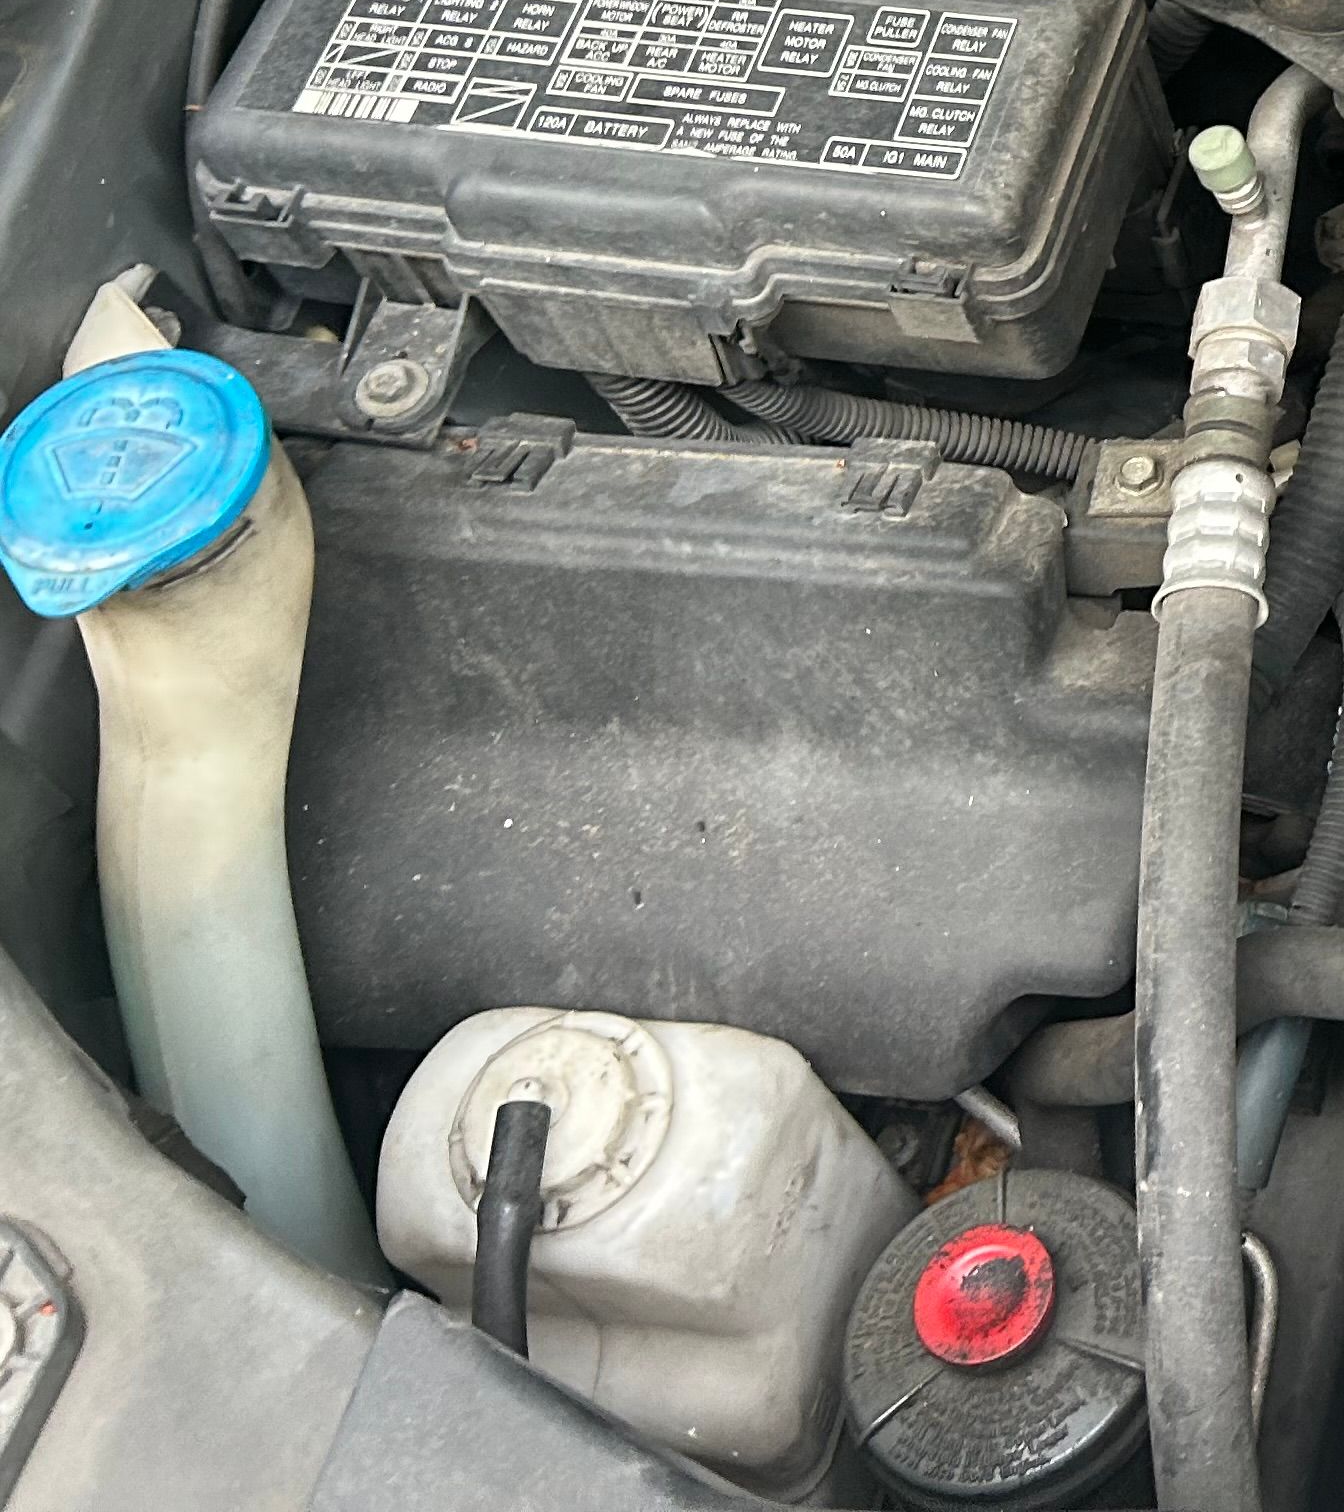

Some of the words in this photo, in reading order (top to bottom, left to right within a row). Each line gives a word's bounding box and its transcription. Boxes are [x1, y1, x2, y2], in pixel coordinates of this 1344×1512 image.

[368, 2, 406, 16] RELAY
[522, 3, 556, 17] HORN
[600, 9, 634, 23] MOTOR
[441, 9, 479, 24] RELAY
[884, 15, 916, 28] FUSE
[513, 17, 551, 32] RELAY
[708, 19, 765, 35] DEFROSTER
[788, 20, 835, 35] HEATER
[940, 23, 988, 38] CONDENSER
[991, 28, 1009, 39] FAN
[873, 25, 919, 39] PULLER
[505, 41, 549, 57] HAZARD
[575, 38, 608, 52] BACK
[784, 35, 827, 50] MOTOR
[951, 38, 987, 53] RELAY
[427, 57, 458, 71] STOP
[701, 51, 747, 65] HEATER
[780, 50, 819, 65] RELAY
[863, 52, 917, 66] CONDENSER
[698, 62, 741, 76] MOTOR
[876, 63, 896, 73] FAN
[925, 64, 968, 78] COOLING
[971, 68, 993, 81] FAN
[413, 80, 447, 93] RADIO
[575, 72, 625, 87] COOLING
[583, 83, 608, 95] FAN
[935, 80, 971, 94] RELAY
[663, 85, 703, 100] SPARE
[708, 90, 748, 105] FUSES
[931, 108, 976, 122] CLUTCH
[538, 115, 567, 130] 120A
[583, 120, 649, 139] BATTERY
[681, 112, 722, 127] ALWAYS
[727, 116, 771, 132] REPLACE
[776, 121, 802, 134] WITH
[918, 122, 955, 136] RELAY
[675, 125, 685, 136] A
[689, 126, 715, 139] NEW
[717, 129, 745, 143] FUSE
[749, 132, 765, 144] OF
[769, 134, 790, 147] THE
[913, 152, 948, 169] MAIN
